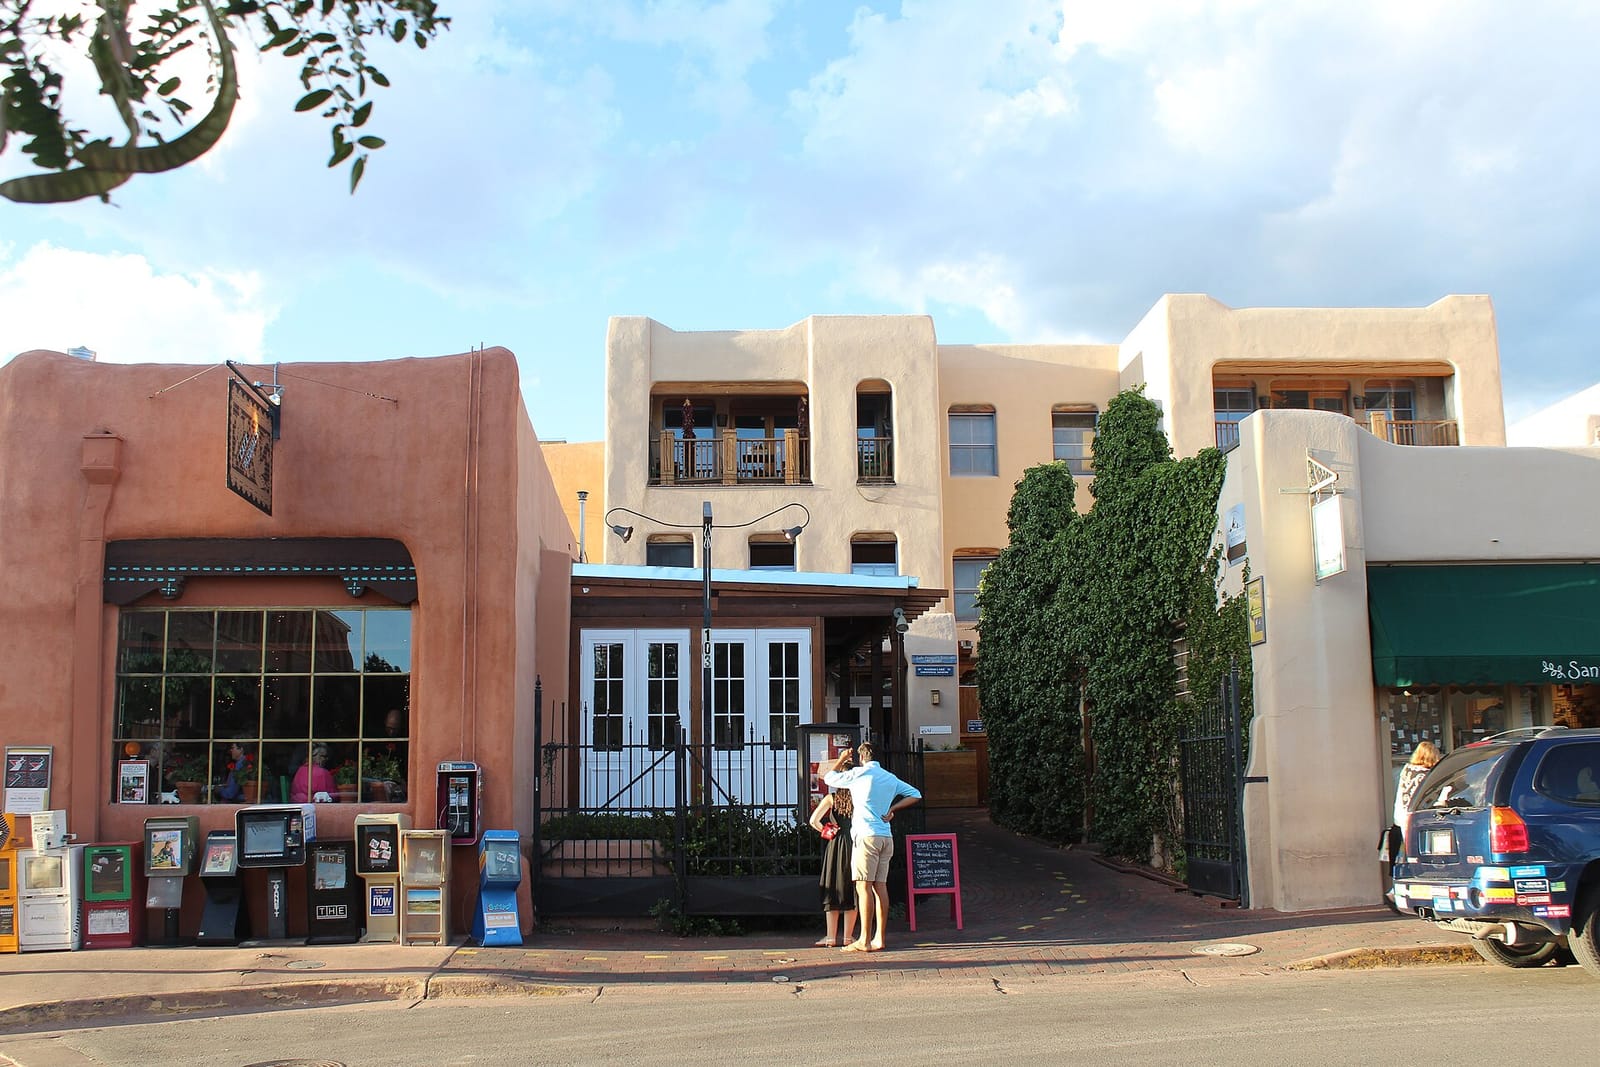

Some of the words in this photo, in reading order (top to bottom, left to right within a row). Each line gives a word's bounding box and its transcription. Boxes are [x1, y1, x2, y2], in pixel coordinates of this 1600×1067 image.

[1568, 660, 1600, 680] San
[321, 856, 343, 864] THE
[373, 896, 392, 907] now
[319, 906, 345, 915] THE
